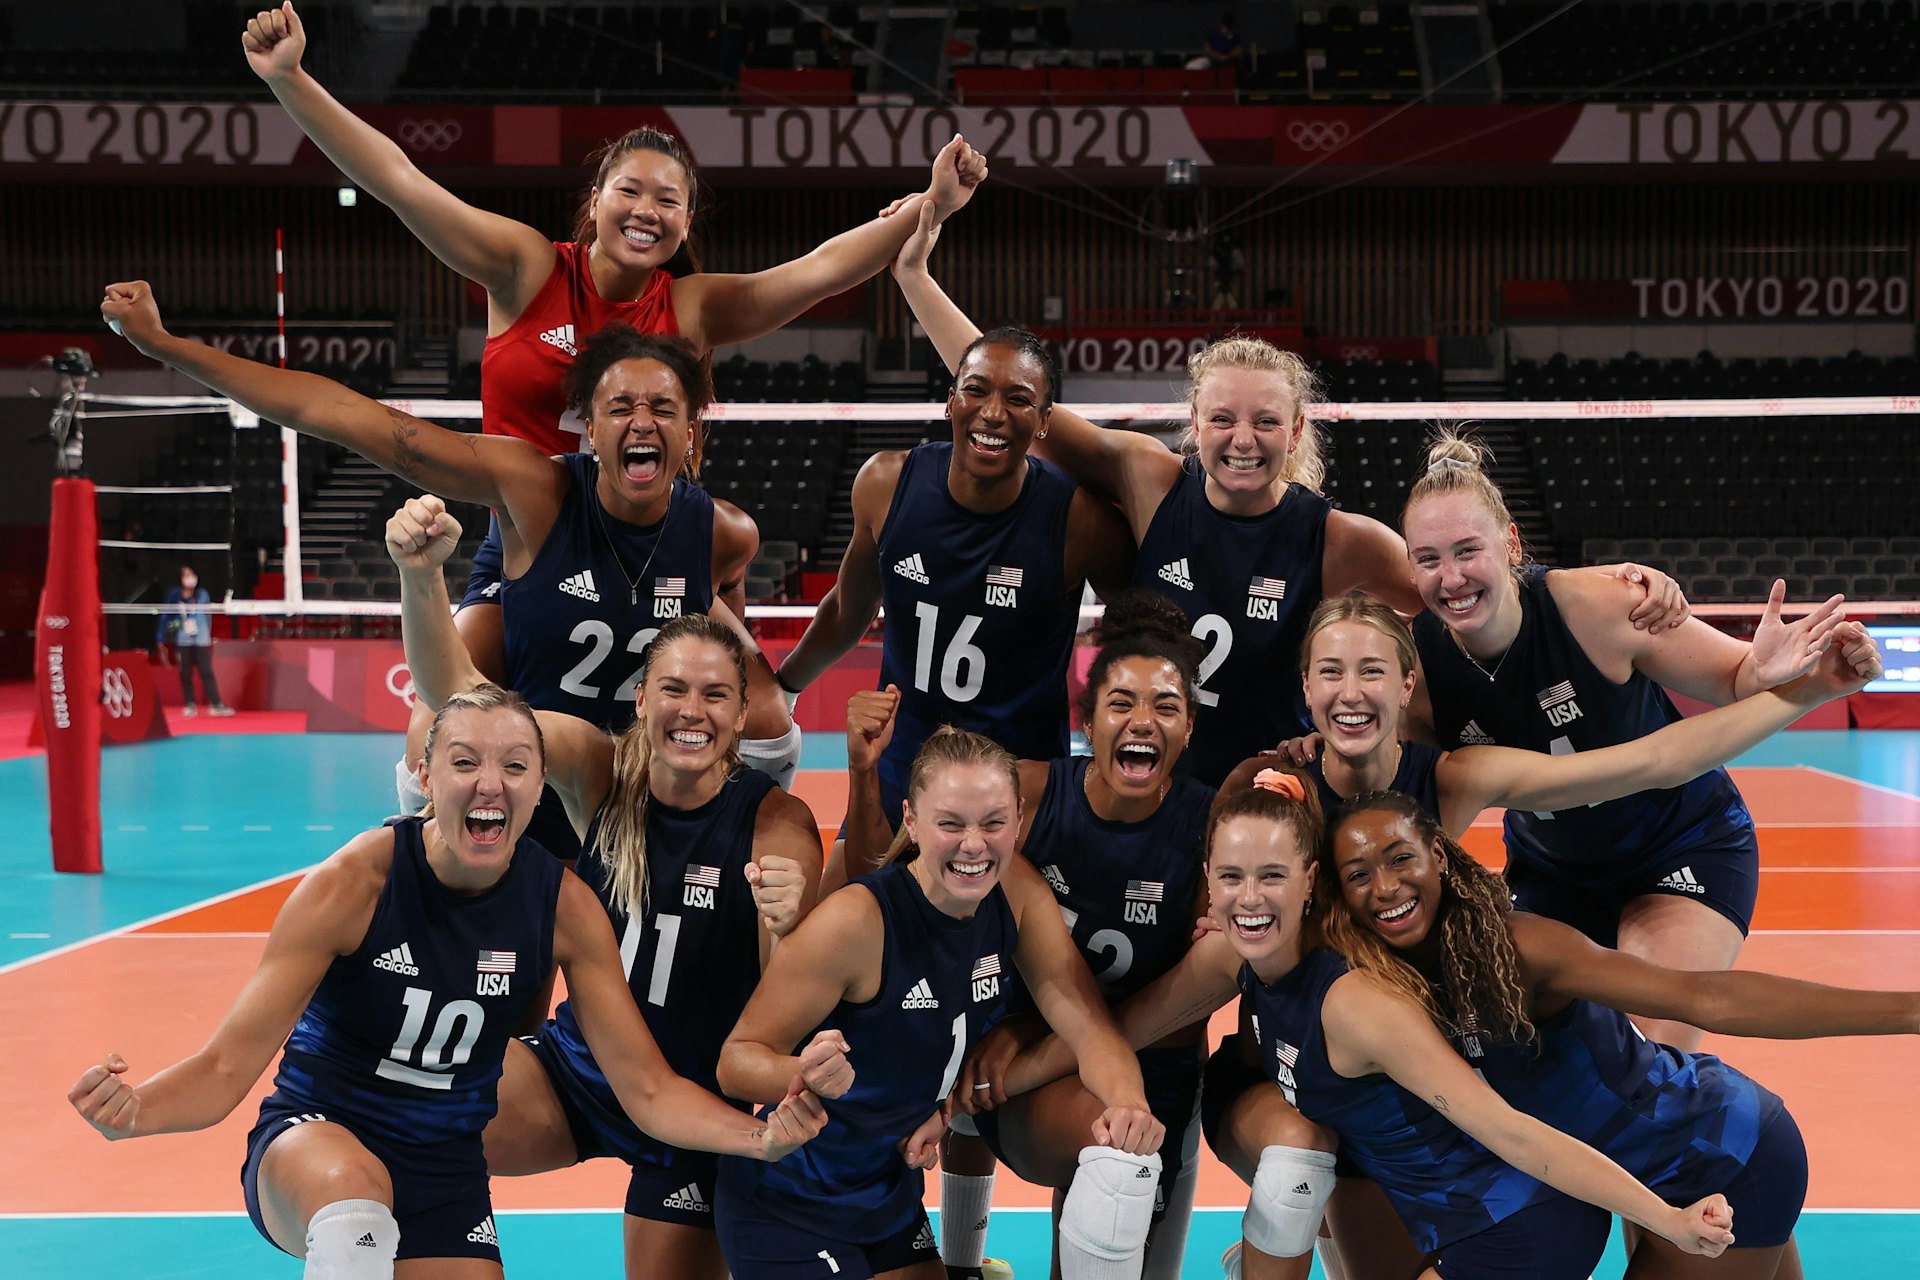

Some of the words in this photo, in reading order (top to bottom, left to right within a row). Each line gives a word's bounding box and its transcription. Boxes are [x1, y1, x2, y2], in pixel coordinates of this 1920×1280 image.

[87, 105, 258, 164] 2020
[729, 108, 959, 167] TOKYO
[983, 107, 1149, 167] 2020
[1616, 102, 1851, 163] TOKYO
[1631, 276, 1783, 318] TOKYO
[1796, 276, 1908, 317] 2020
[540, 332, 578, 356] adidas
[1577, 402, 1619, 415] TOKYO
[1621, 402, 1653, 415] 2020
[894, 564, 929, 585] adidas
[1158, 568, 1194, 591] adidas
[481, 582, 501, 597] 4
[558, 582, 600, 603] adidas
[985, 585, 1016, 608] USA
[653, 598, 682, 619] USA
[1246, 597, 1278, 622] USA
[560, 620, 662, 701] 22
[915, 601, 986, 702] 16
[1190, 614, 1233, 707] 2
[48, 645, 65, 692] TOKYO
[51, 693, 71, 729] 2020
[1546, 700, 1584, 727] USA
[1459, 735, 1496, 744] adidas
[683, 885, 714, 909] USA
[1657, 880, 1705, 894] adidas
[1124, 901, 1157, 925] USA
[1058, 904, 1134, 985] 2
[373, 958, 419, 976] adidas
[476, 973, 510, 996] USA
[972, 976, 1000, 1002] USA
[902, 997, 939, 1009] adidas
[389, 987, 485, 1071] 10
[935, 1012, 966, 1102] 1
[1465, 1035, 1485, 1058] USA
[1277, 1060, 1297, 1089] USA
[663, 1198, 710, 1212] adidas
[467, 1232, 498, 1247] adid
[817, 1249, 840, 1274] 1
